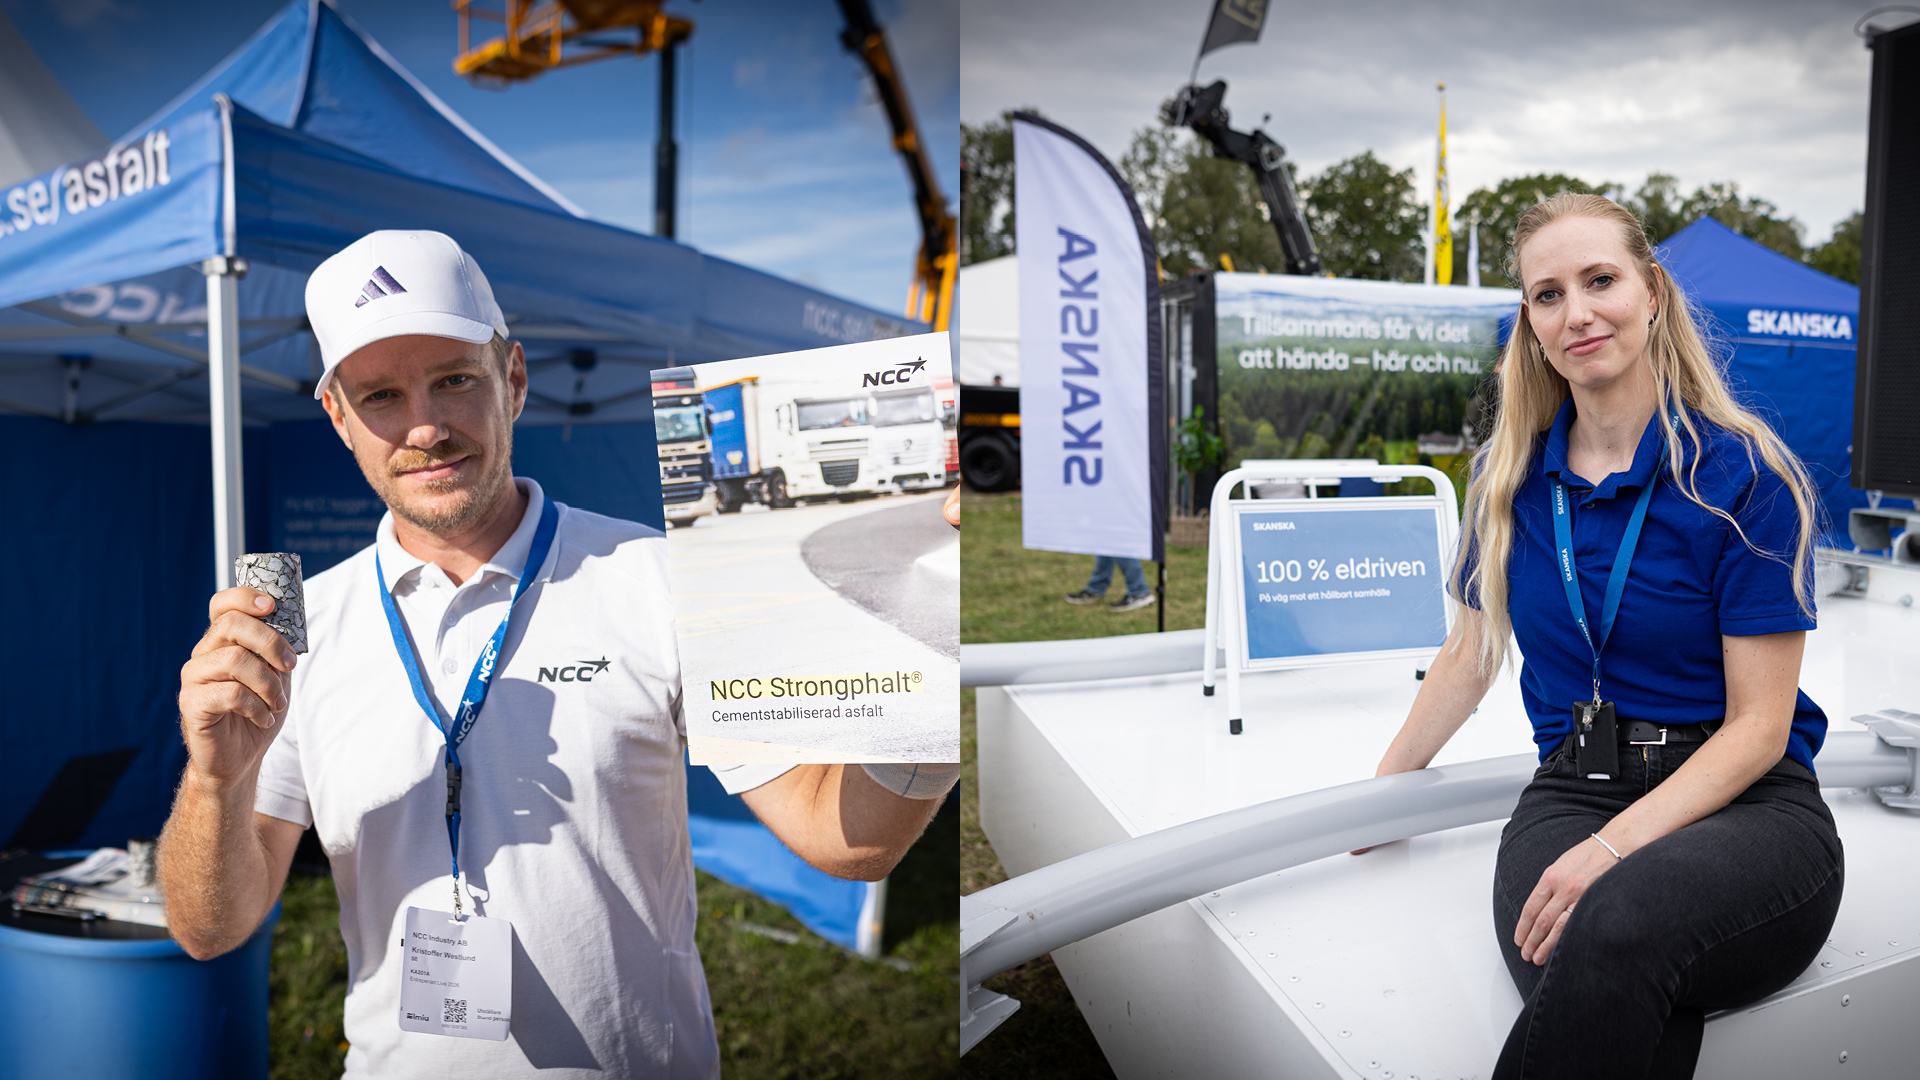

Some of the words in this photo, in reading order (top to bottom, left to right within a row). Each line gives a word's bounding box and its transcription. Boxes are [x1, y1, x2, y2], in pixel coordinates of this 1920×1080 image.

[0, 128, 171, 240] .se/asfalt
[1242, 312, 1383, 340] Tillsammans
[1384, 316, 1415, 341] får
[1416, 320, 1434, 342] vi
[1436, 322, 1471, 343] det
[1747, 308, 1853, 340] SKANSKA
[1238, 347, 1275, 369] att
[1277, 345, 1349, 371] hända
[1372, 348, 1409, 372] här
[1411, 351, 1450, 374] och
[862, 367, 911, 389] NCC
[1556, 484, 1565, 516] SKANSKA
[1253, 521, 1296, 531] SKANSKA
[1257, 560, 1302, 583] 100
[1308, 559, 1330, 581] %
[1335, 557, 1426, 580] eldriven
[1561, 547, 1573, 582] SKANSKA
[1259, 593, 1271, 603] På
[1272, 593, 1288, 603] väg
[1290, 591, 1306, 601] mot
[1308, 590, 1320, 600] ett
[1320, 588, 1353, 600] hållbart
[1354, 588, 1391, 598] samhälle
[478, 648, 497, 684] NCC
[537, 666, 594, 683] NCC
[710, 678, 763, 701] NCC
[712, 706, 840, 722] Cementstabiliserad
[845, 704, 884, 718] asfalt
[455, 710, 476, 744] NCC
[412, 932, 428, 941] NCC
[429, 935, 456, 946] Industry
[411, 946, 443, 957] Kristoffer
[443, 952, 476, 962] Westlund
